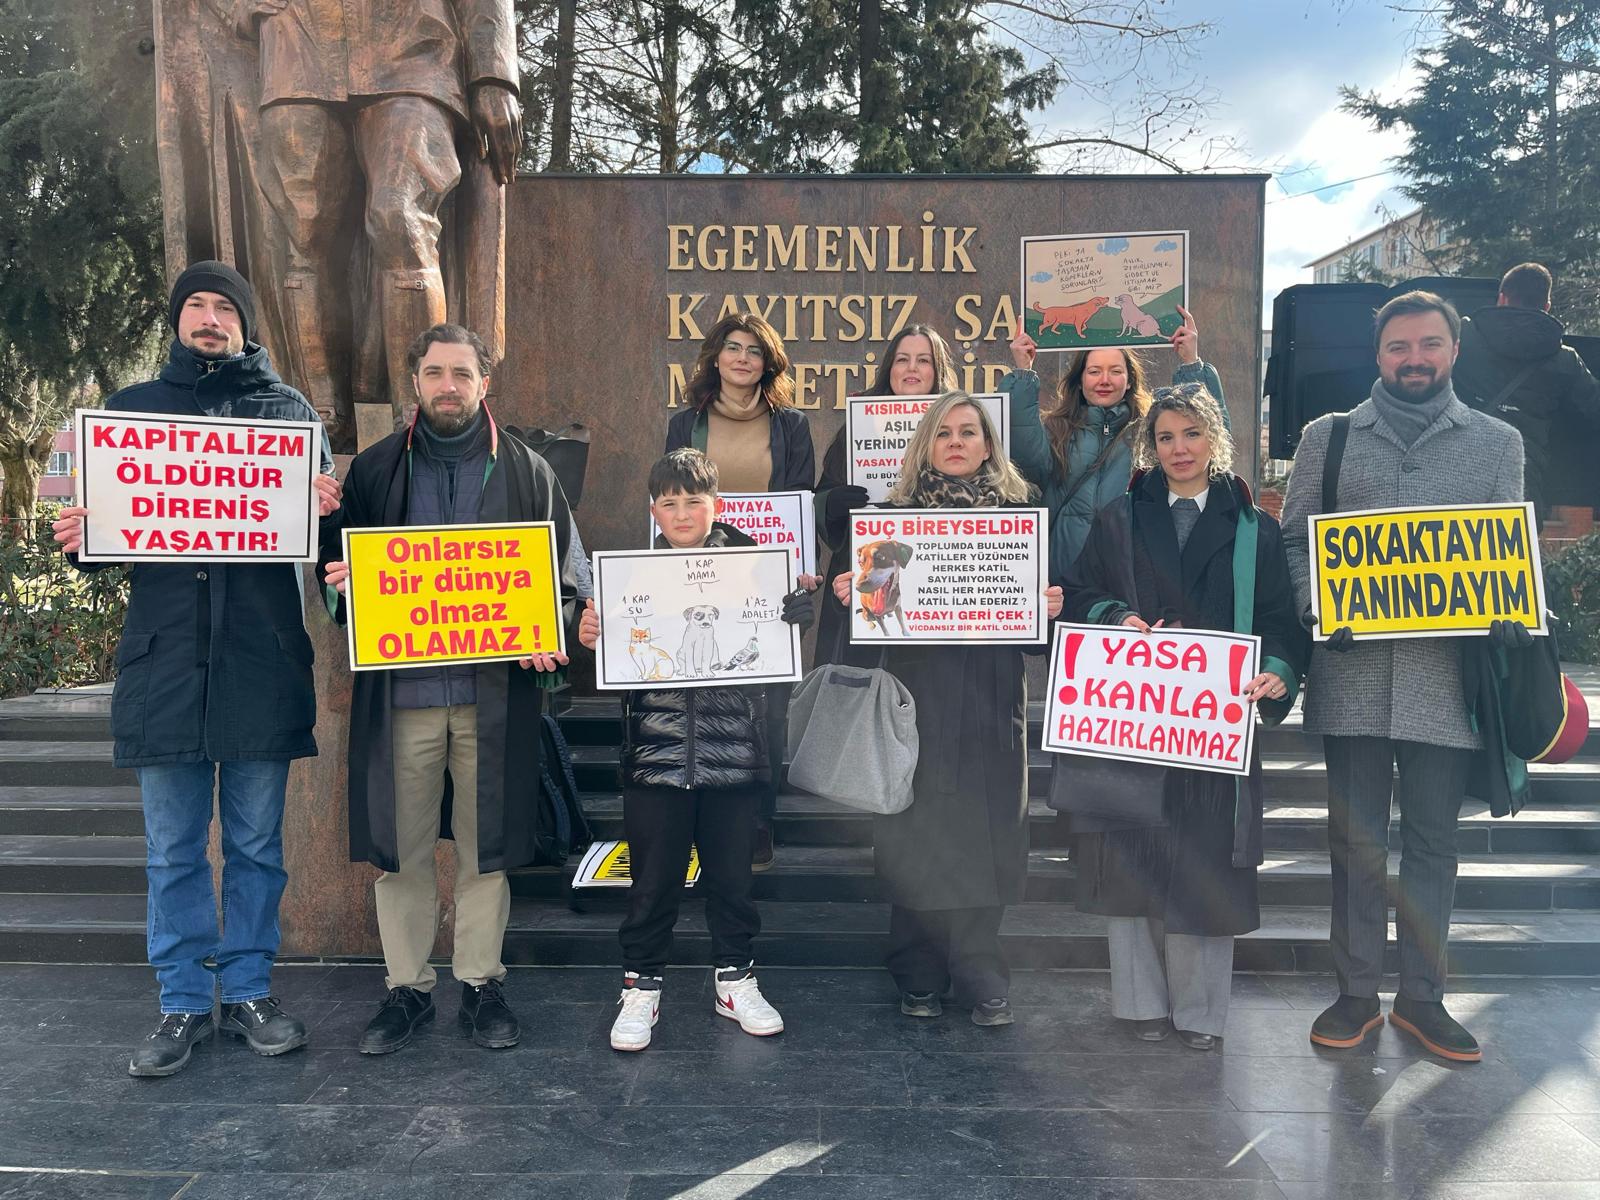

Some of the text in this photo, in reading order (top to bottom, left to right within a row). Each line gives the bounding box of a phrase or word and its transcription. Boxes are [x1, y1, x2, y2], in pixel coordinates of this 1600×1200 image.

[667, 210, 977, 273] EGEMENLİK
[93, 424, 304, 456] KAPİTALİZM
[855, 436, 911, 450] YERİND
[856, 458, 897, 467] YASAYI
[116, 457, 283, 489] ÖLDÜRÜR
[132, 492, 270, 522] DİRENİŞ
[855, 516, 1034, 540] SUÇ BİREYSELDİR
[121, 529, 278, 552] YAŞATIR!
[777, 532, 795, 543] DA
[916, 542, 1029, 550] TOPLUMDA BULUNAN
[1324, 518, 1525, 570] SOKAKTAYIM
[386, 536, 521, 563] Onlarsız
[916, 551, 1029, 561] KATİLLER YÜZÜNDEN
[685, 559, 714, 569] 1 KAP
[932, 562, 1010, 572] HERKES KATİL
[379, 566, 531, 595] bir dünya
[687, 570, 716, 581] MAMA
[927, 575, 1018, 584] SAYILMIYORKEN,
[632, 594, 650, 604] KAP
[918, 586, 1024, 594] NASIL HER HAYVANI
[1328, 570, 1530, 622] YANINDAYIM
[628, 606, 643, 614] SU
[918, 596, 949, 606] KATİL
[952, 596, 977, 606] İLAN
[980, 596, 1019, 606] EDERİZ
[409, 600, 508, 626] olmaz
[904, 610, 954, 621] YASAYI
[958, 608, 991, 620] GERİ
[995, 610, 1024, 622] ÇEK
[909, 623, 955, 631] VİCDANSIZ
[957, 623, 972, 631] BİR
[975, 623, 1000, 631] KATİL
[378, 627, 522, 660] OLAMAZ
[1102, 637, 1208, 673] YASA
[1083, 678, 1218, 720] KANLA
[1058, 714, 1242, 762] HAZIRLANMAZ
